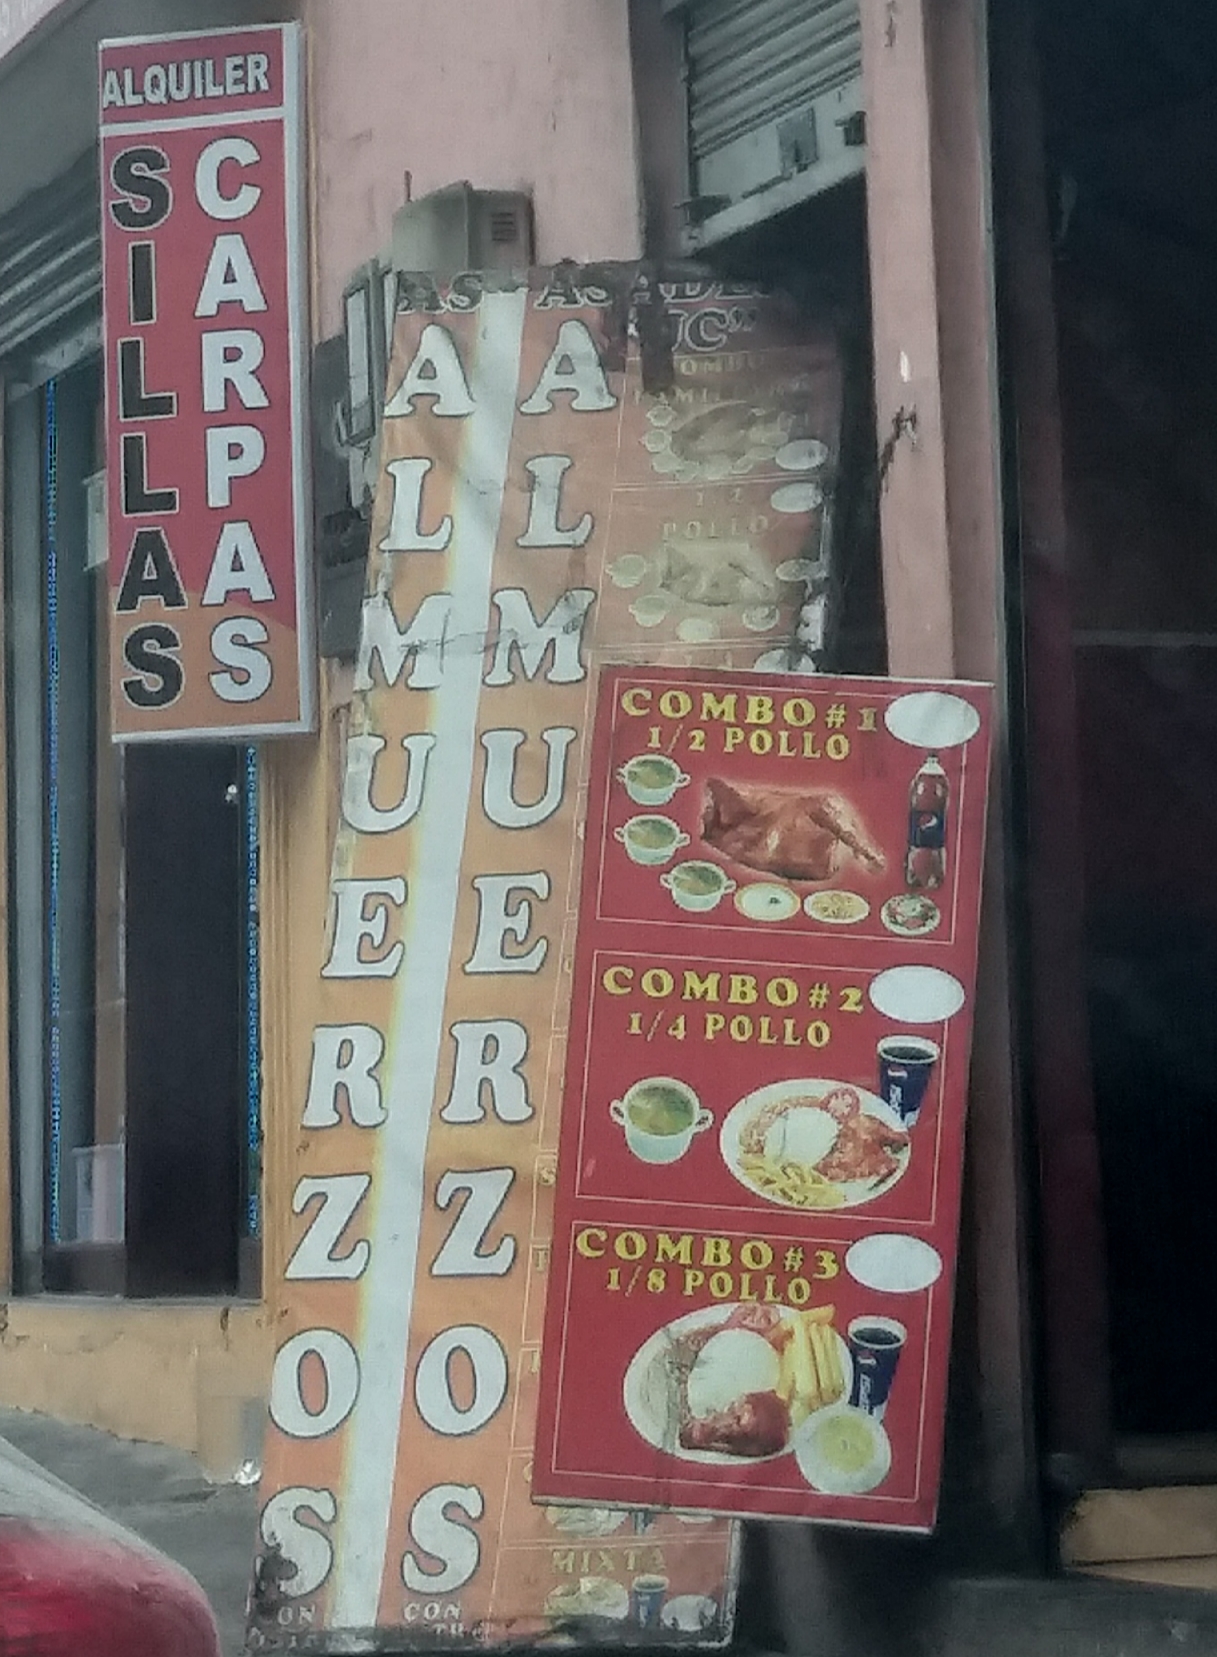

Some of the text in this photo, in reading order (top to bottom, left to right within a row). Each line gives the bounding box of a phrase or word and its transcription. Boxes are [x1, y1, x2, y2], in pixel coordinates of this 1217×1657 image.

[102, 53, 269, 111] ALQUILER
[108, 142, 185, 711] SILLAS
[193, 135, 277, 705] CARPAS
[647, 723, 852, 761] 1/2 POLLO
[626, 1008, 832, 1049] 1/4 POLLO
[605, 1265, 812, 1305] 1/8 POLLO
